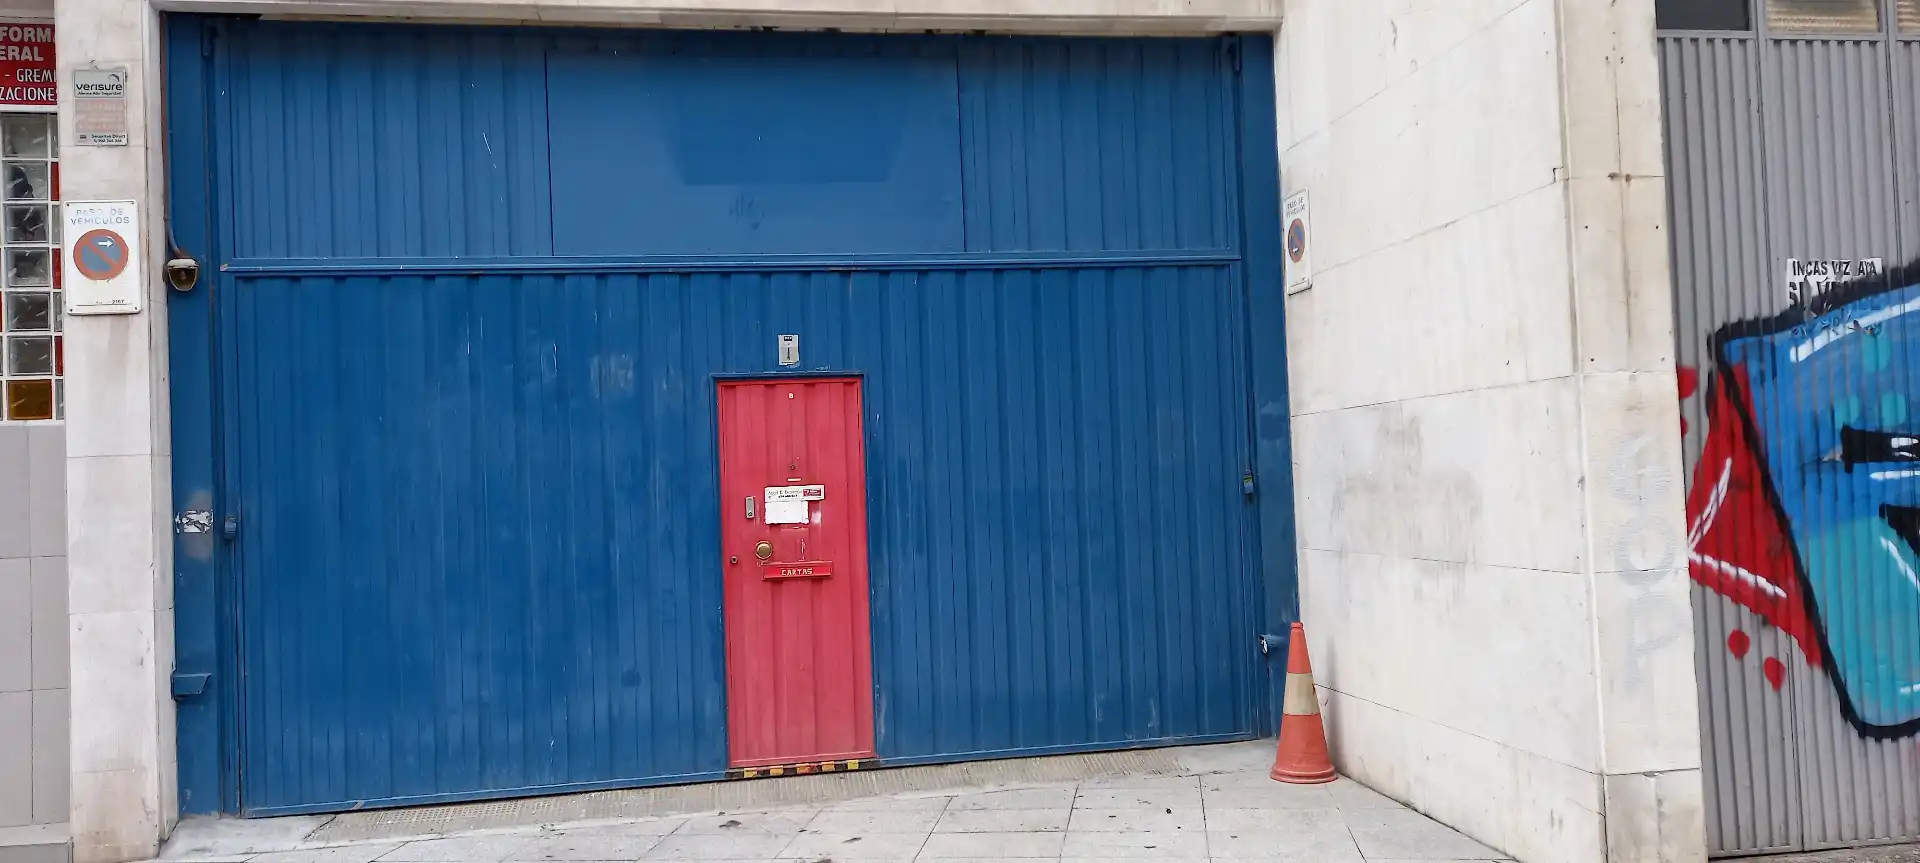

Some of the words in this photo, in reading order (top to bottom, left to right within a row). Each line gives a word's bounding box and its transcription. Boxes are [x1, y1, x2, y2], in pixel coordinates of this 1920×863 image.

[76, 83, 122, 91] verisure
[70, 216, 130, 225] VEHICULOS
[781, 568, 813, 576] CARTAS
